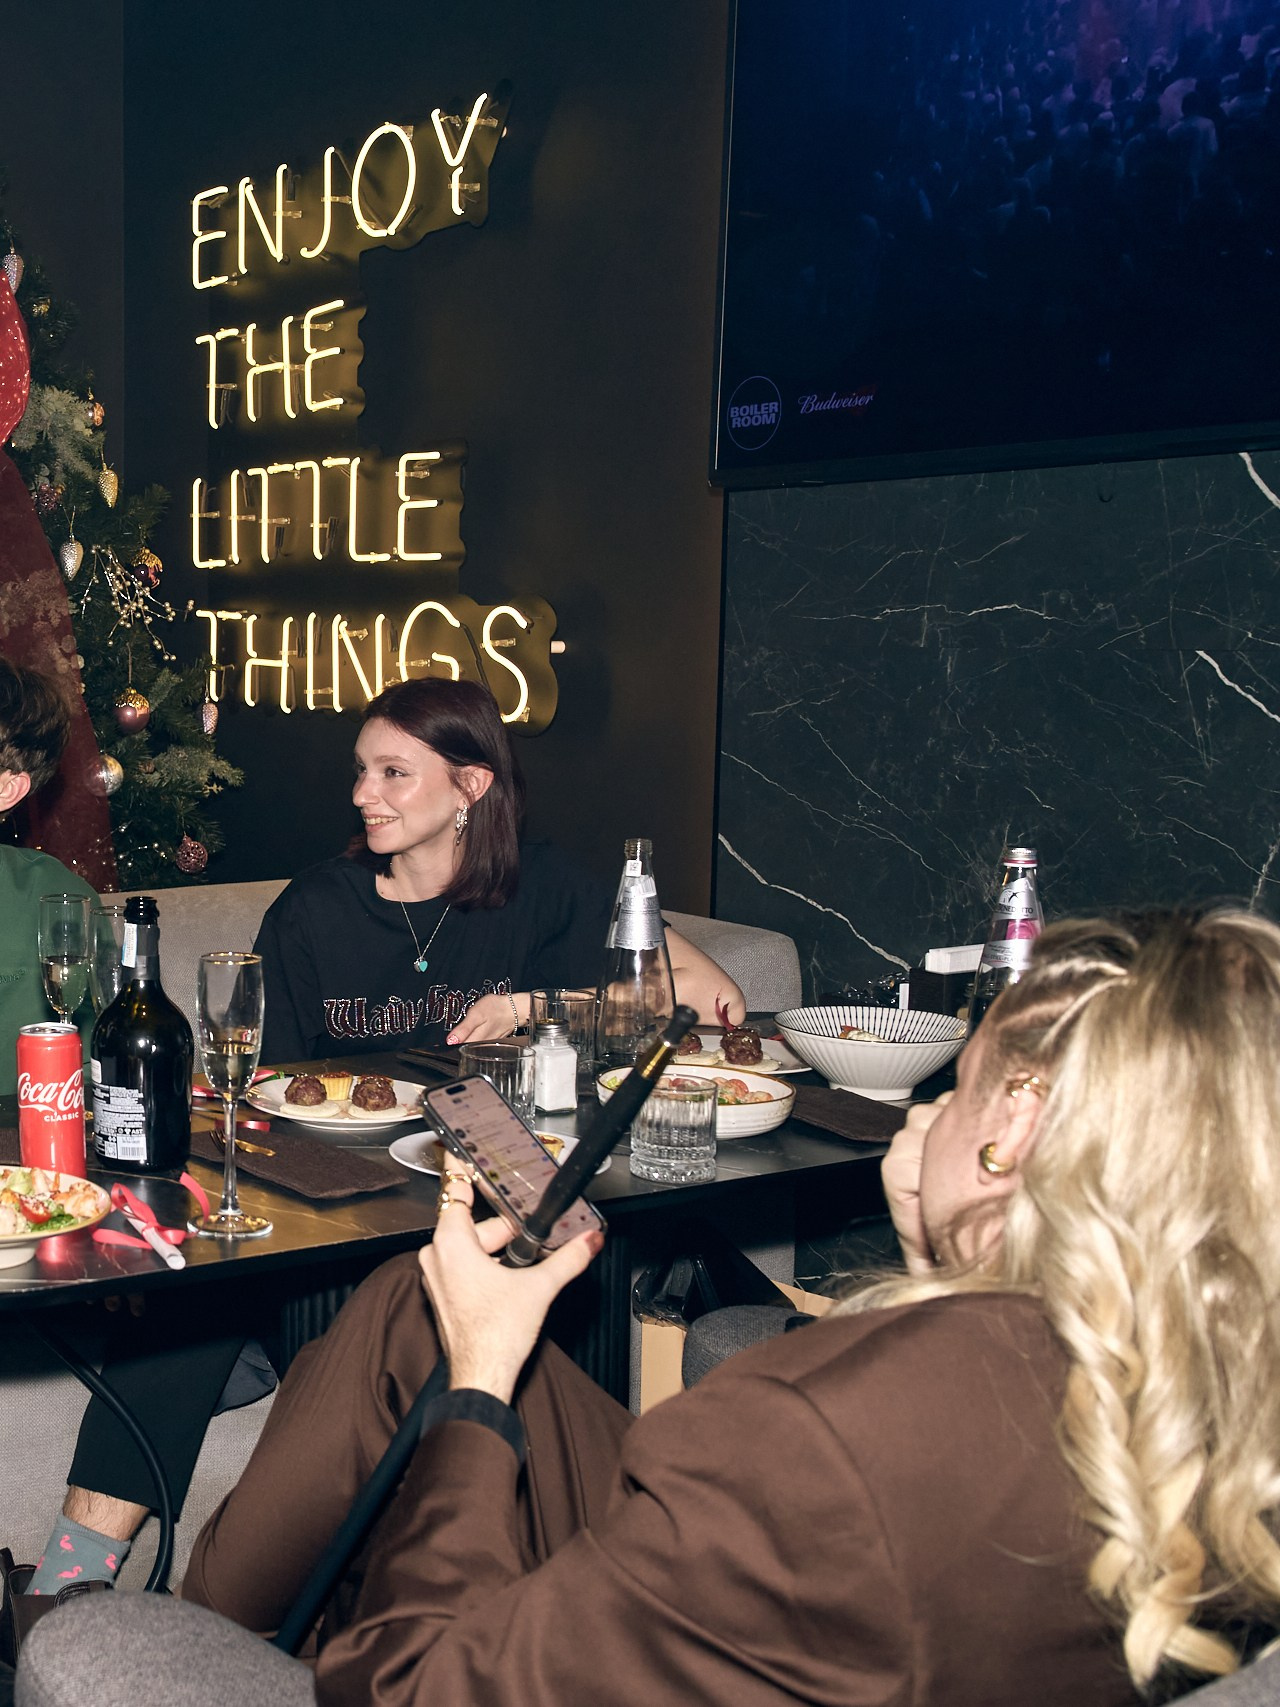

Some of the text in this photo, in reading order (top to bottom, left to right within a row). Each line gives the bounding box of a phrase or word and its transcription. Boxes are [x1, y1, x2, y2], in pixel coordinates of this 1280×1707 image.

[192, 93, 488, 290] ENJOY
[196, 300, 344, 429] THE
[730, 402, 779, 418] BOILER
[731, 413, 776, 429] ROOM
[798, 392, 874, 415] Budweiser
[192, 451, 442, 570] LITTLE
[196, 601, 528, 723] THINGS
[18, 1068, 84, 1112] Coca-Co
[43, 1111, 79, 1123] CLASSIC
